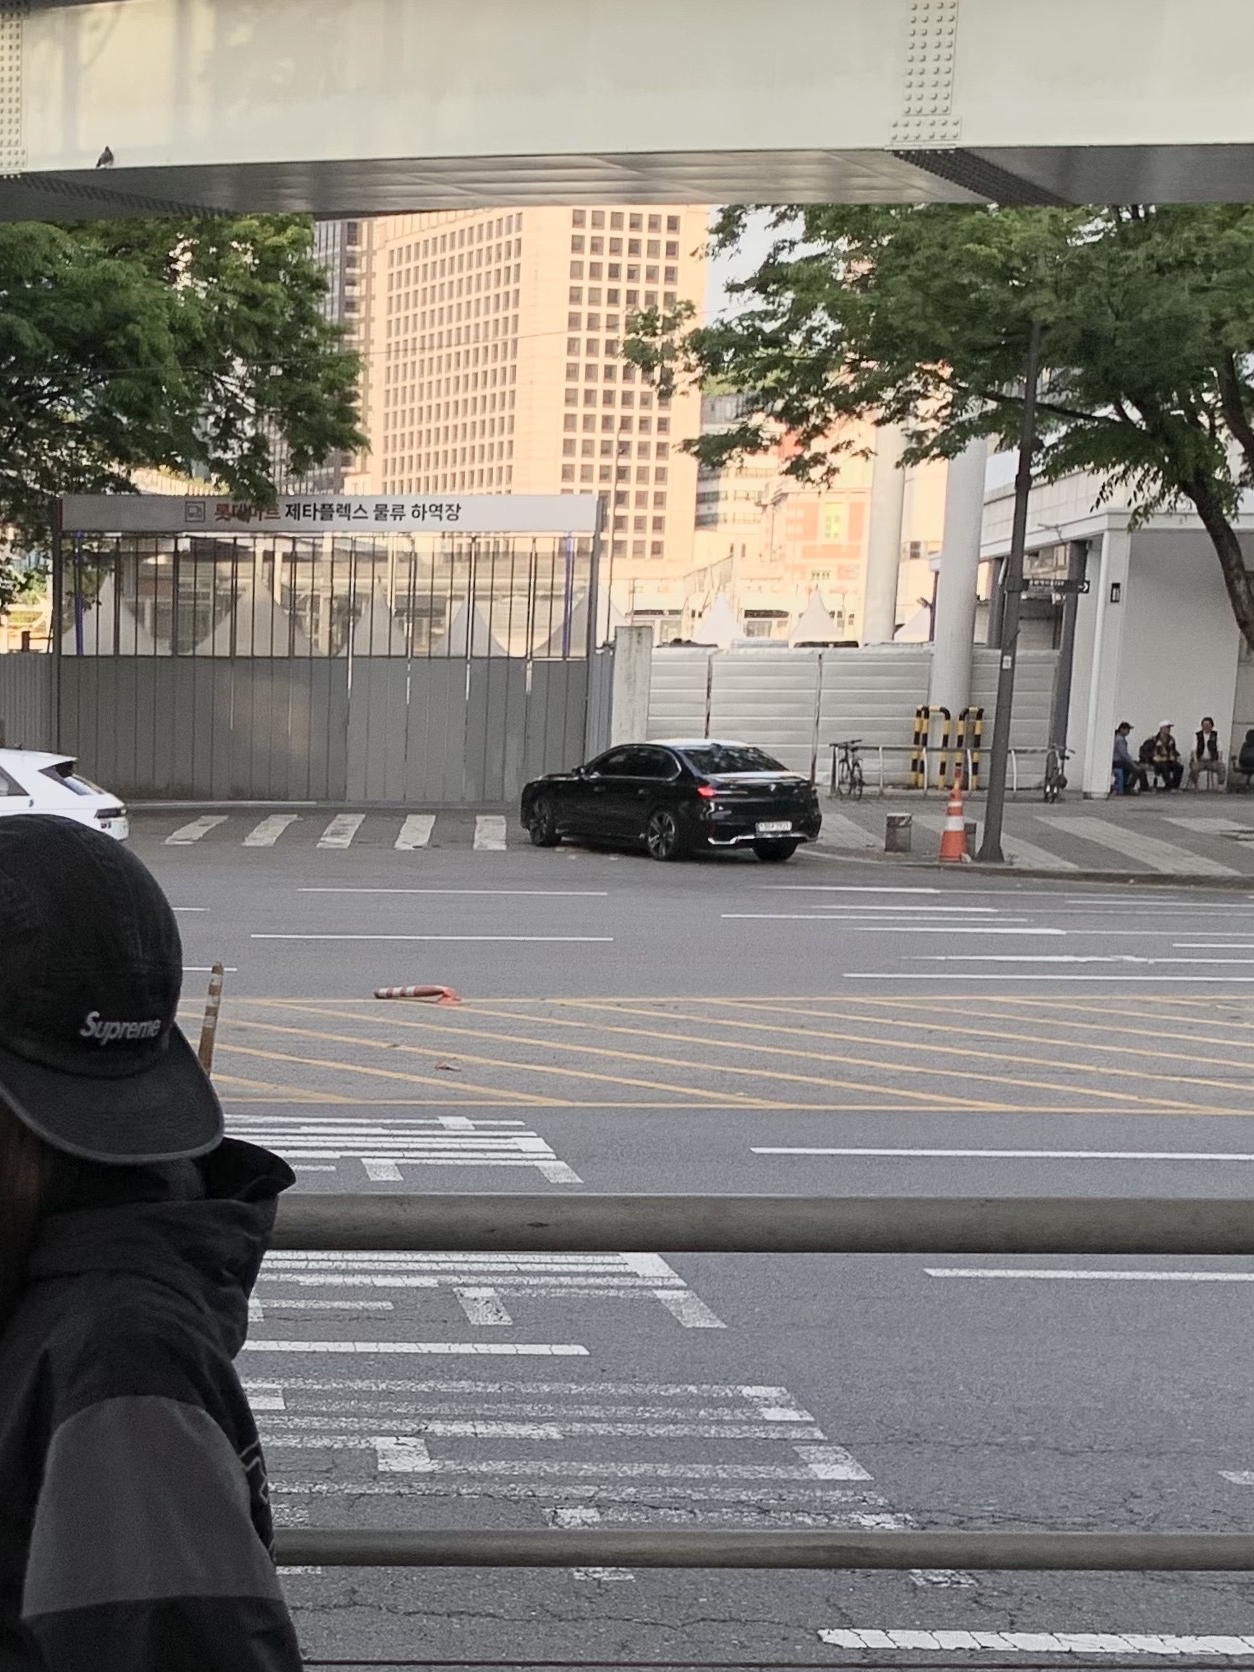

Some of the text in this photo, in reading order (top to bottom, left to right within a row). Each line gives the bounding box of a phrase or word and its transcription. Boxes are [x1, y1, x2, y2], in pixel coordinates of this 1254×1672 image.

[285, 503, 368, 521] 제타플렉스
[373, 504, 406, 521] 물류
[411, 504, 462, 521] 하역장
[79, 1010, 162, 1047] Supreme
